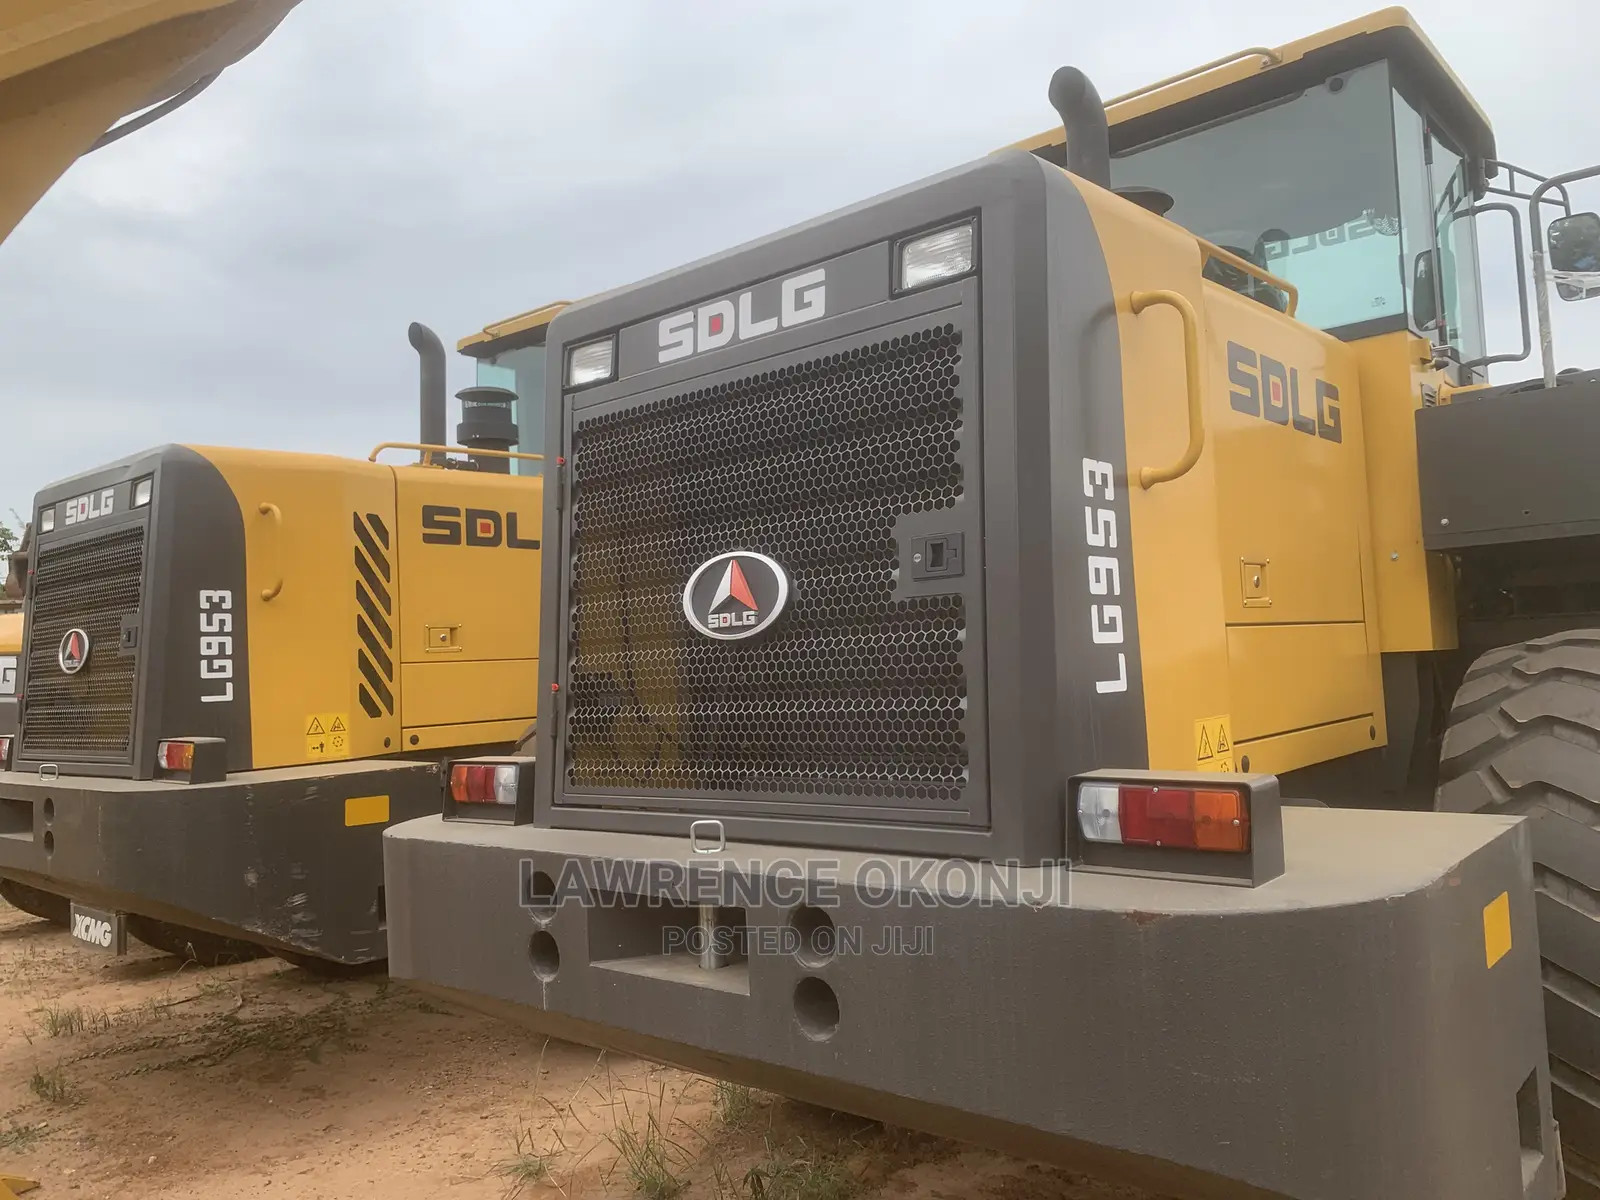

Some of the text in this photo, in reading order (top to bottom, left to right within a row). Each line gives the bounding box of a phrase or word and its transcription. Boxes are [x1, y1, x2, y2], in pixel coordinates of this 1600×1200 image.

[658, 268, 826, 363] SDLG
[1227, 340, 1342, 443] SDLG
[65, 488, 114, 526] SDLG
[421, 504, 541, 550] SDL
[1082, 457, 1127, 694] LG953
[199, 589, 233, 702] LG953
[708, 610, 758, 629] SDLG
[72, 913, 112, 947] XCMG
